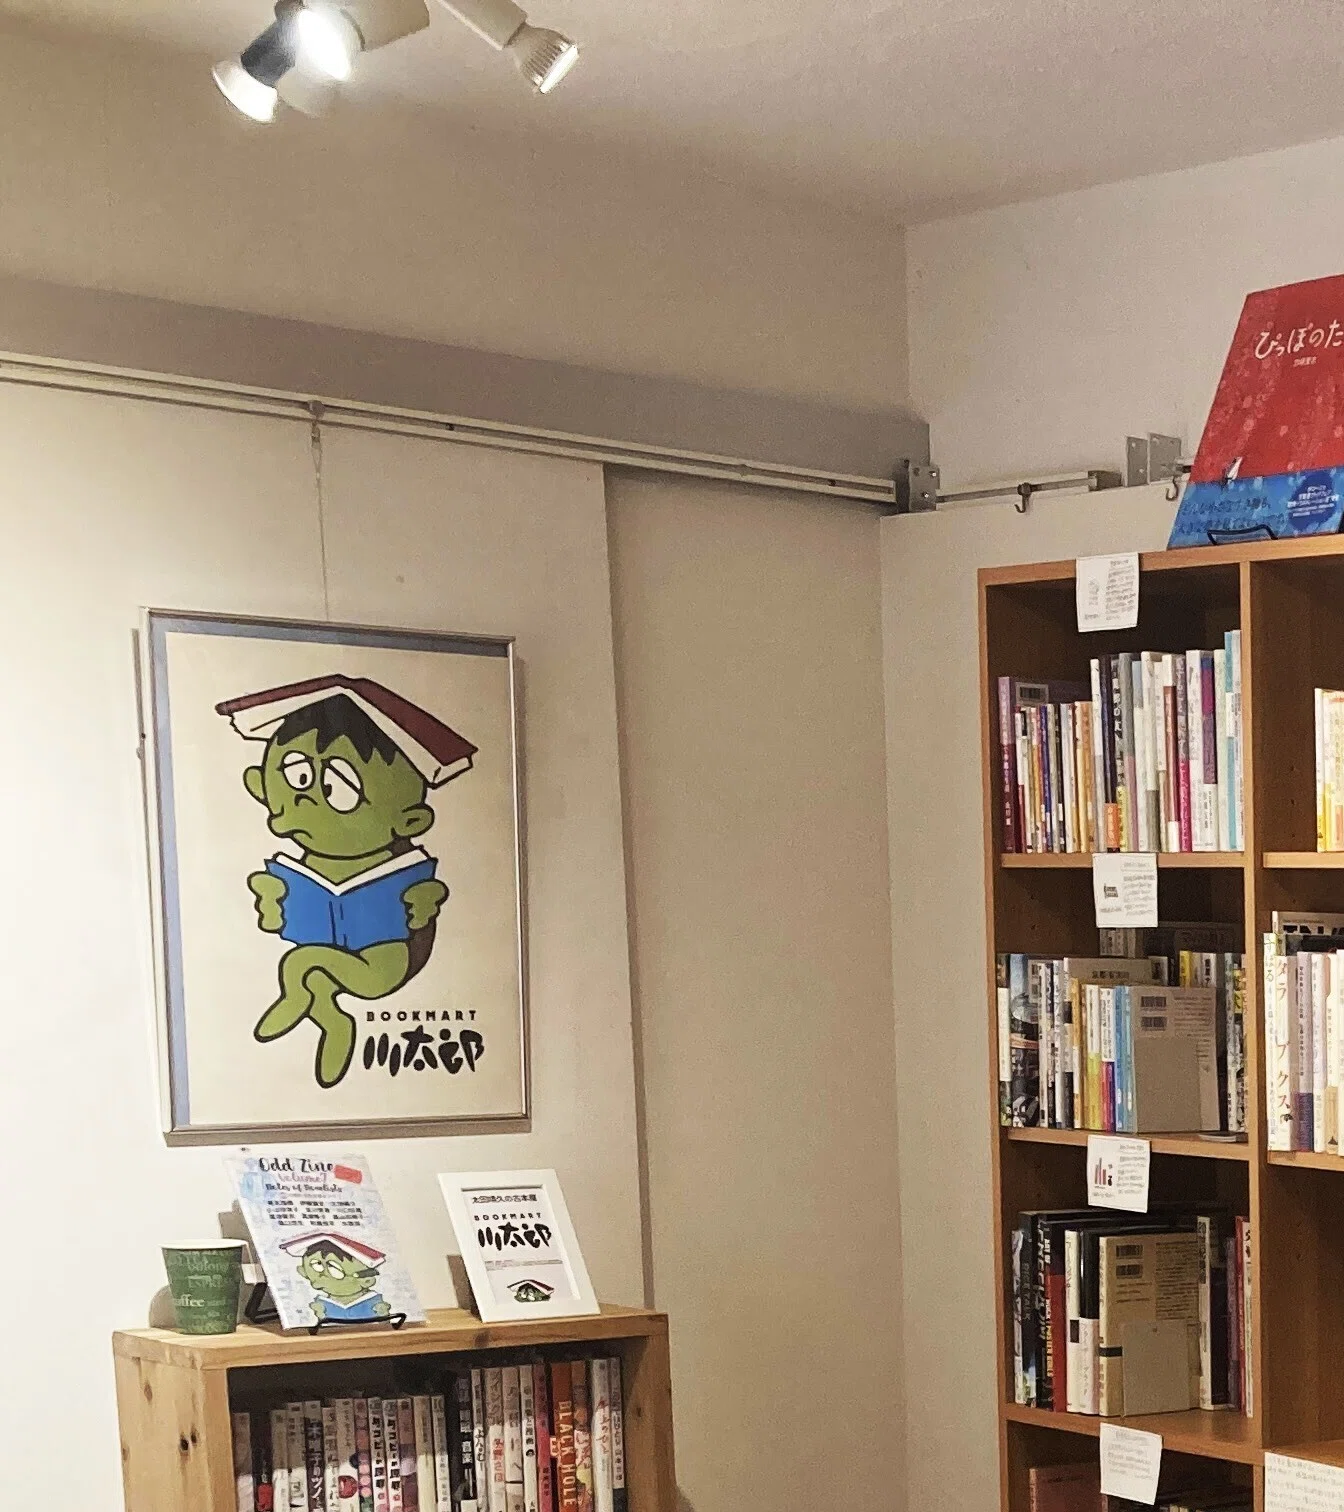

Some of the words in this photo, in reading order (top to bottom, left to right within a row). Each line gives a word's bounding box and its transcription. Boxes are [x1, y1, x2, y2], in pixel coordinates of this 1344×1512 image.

[365, 1009, 480, 1023] BOOKMART
[1275, 961, 1291, 1110] タラブックス
[258, 1157, 295, 1172] Odd
[473, 1212, 542, 1221] BOOKMART
[558, 1400, 574, 1460] BLACK
[562, 1462, 576, 1507] HOLE
